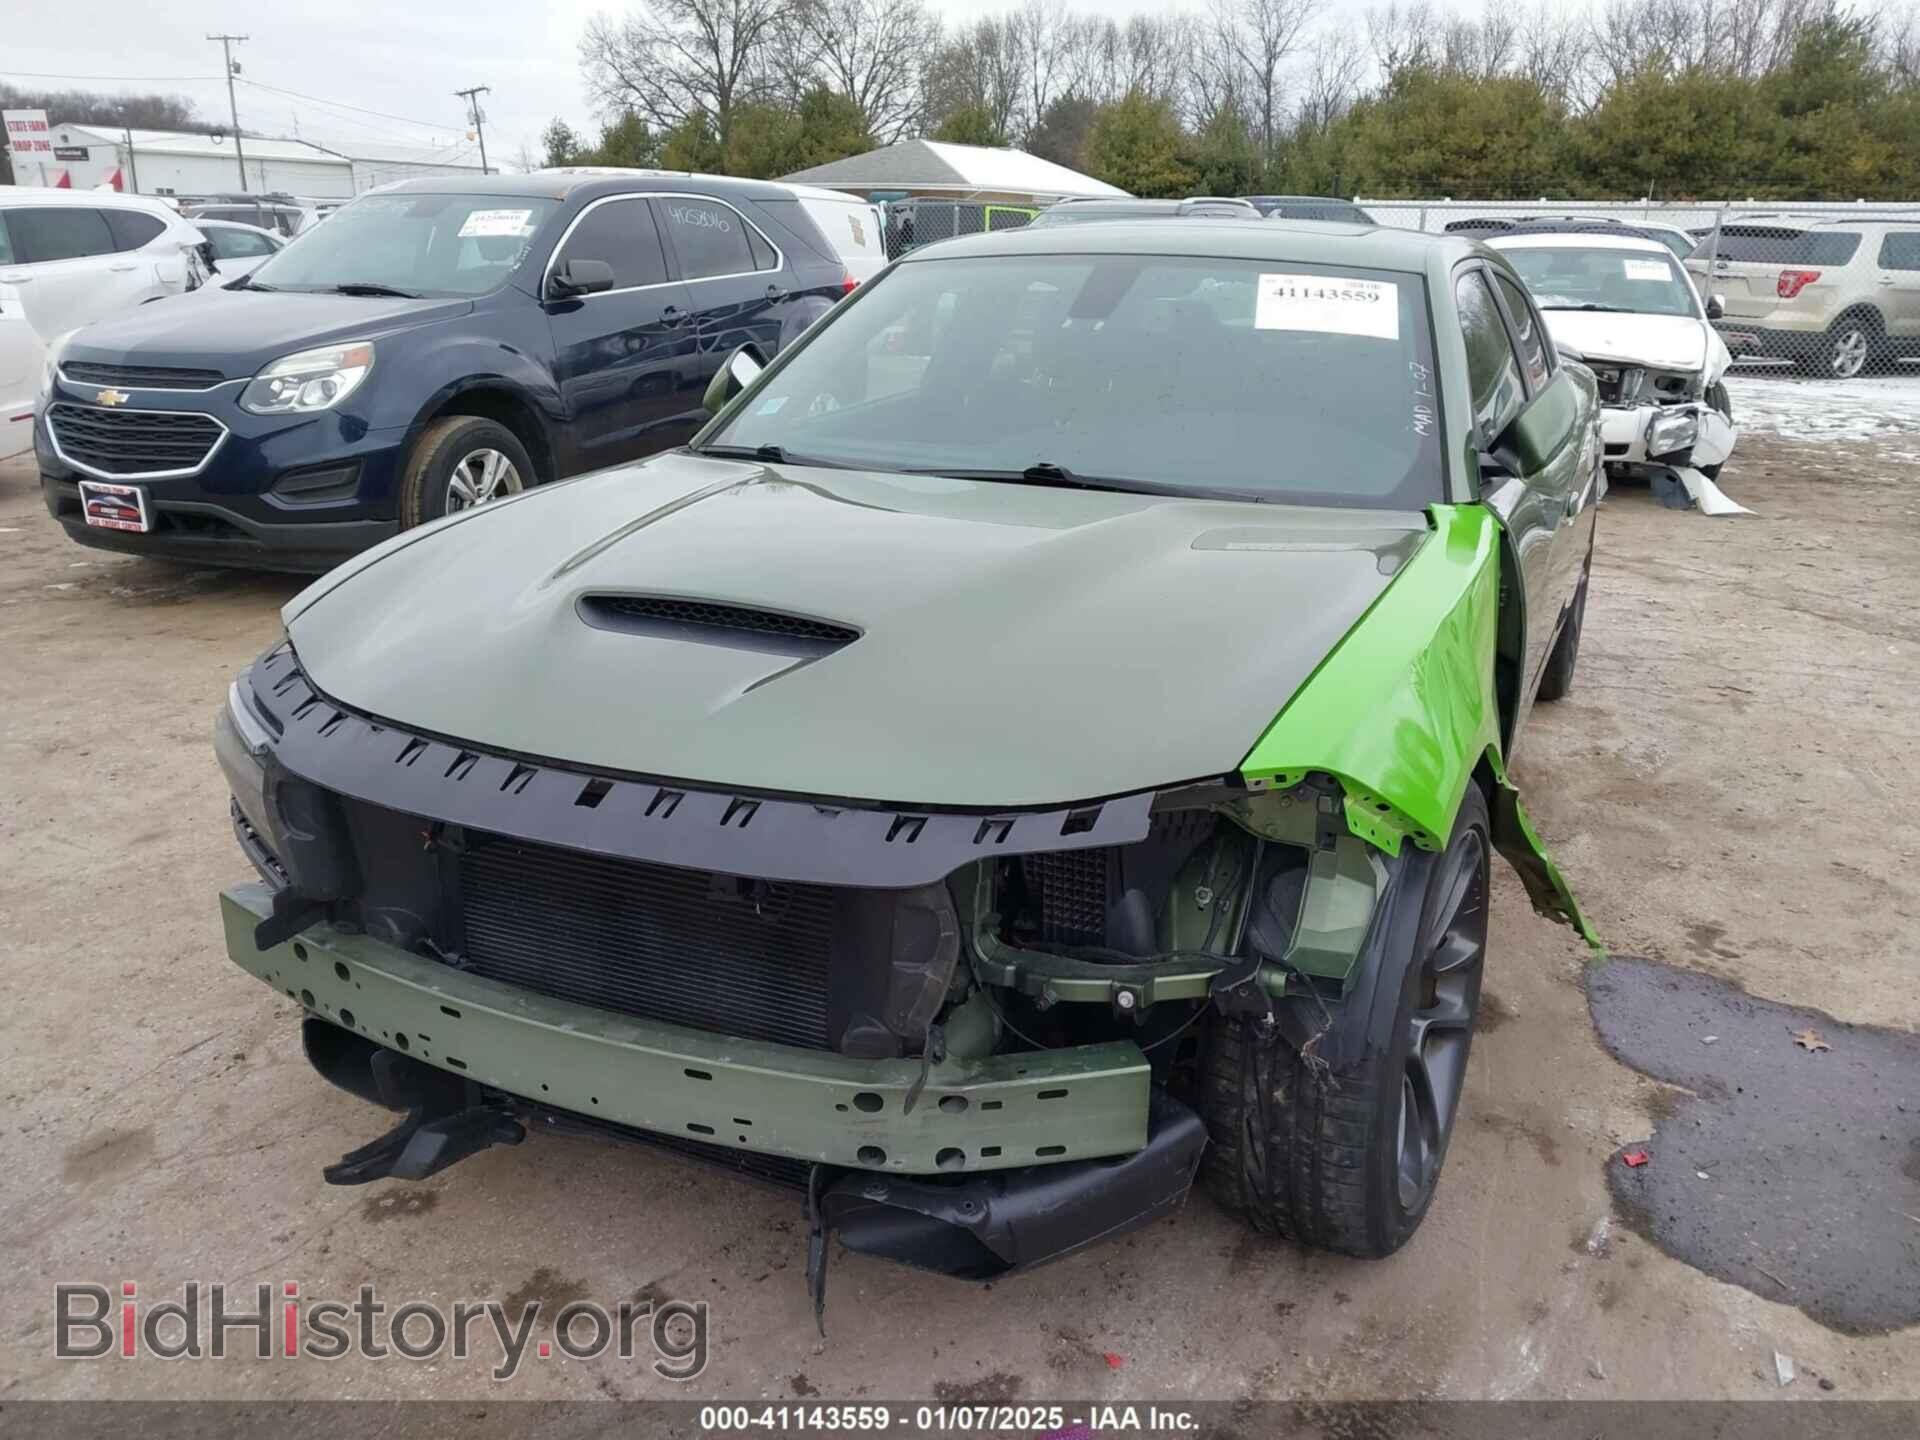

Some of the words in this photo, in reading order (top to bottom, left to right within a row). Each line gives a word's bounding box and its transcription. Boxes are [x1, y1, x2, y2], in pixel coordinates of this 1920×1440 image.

[6, 120, 28, 132] STATE
[29, 120, 48, 132] FARM
[13, 140, 32, 152] DROP
[33, 140, 51, 152] ZONE
[1271, 287, 1380, 303] 41143559
[1408, 361, 1433, 397] 1-07
[1413, 404, 1433, 436] MAD
